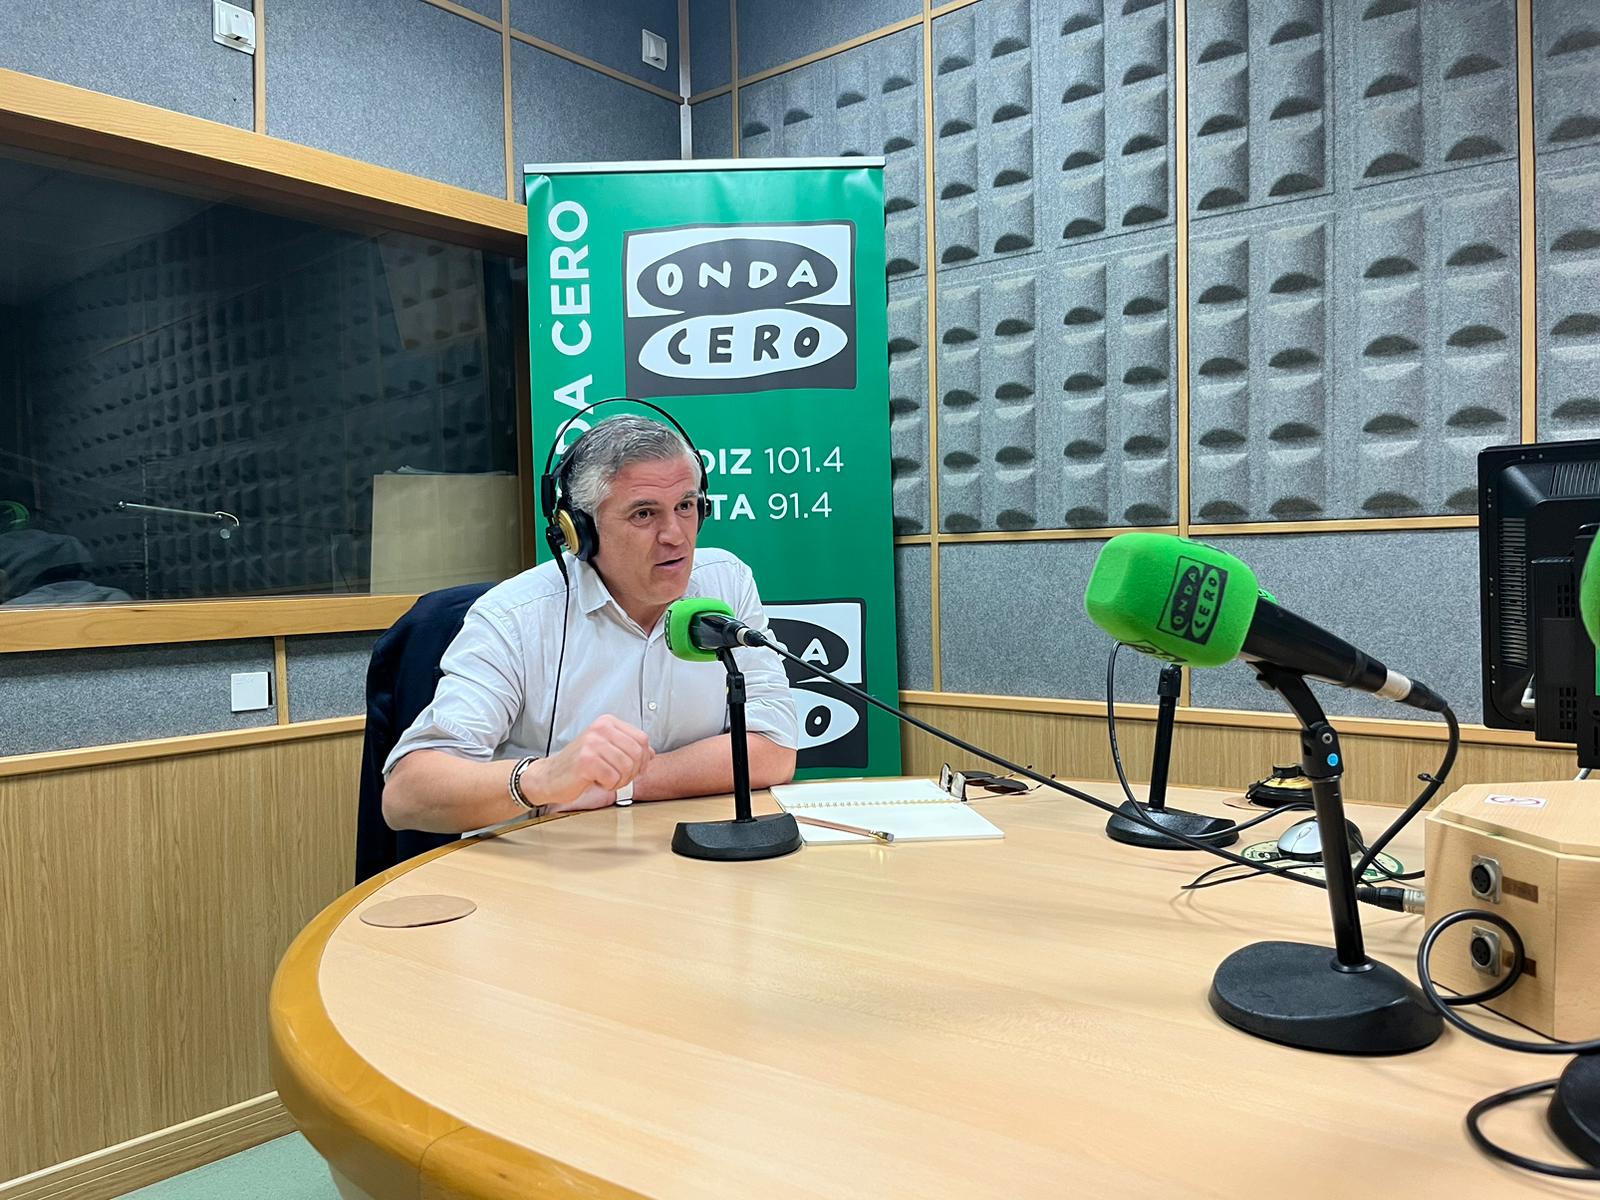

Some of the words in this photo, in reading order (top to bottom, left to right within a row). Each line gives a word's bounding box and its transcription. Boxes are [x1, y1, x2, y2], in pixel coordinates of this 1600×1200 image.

[548, 200, 592, 356] CERO
[656, 260, 818, 296] ONDA
[667, 324, 820, 365] CERO
[699, 448, 752, 475] DIZ
[764, 446, 844, 474] 101.4
[768, 491, 832, 520] 91.4
[1173, 572, 1197, 625] ONDA
[1194, 576, 1218, 629] CERO
